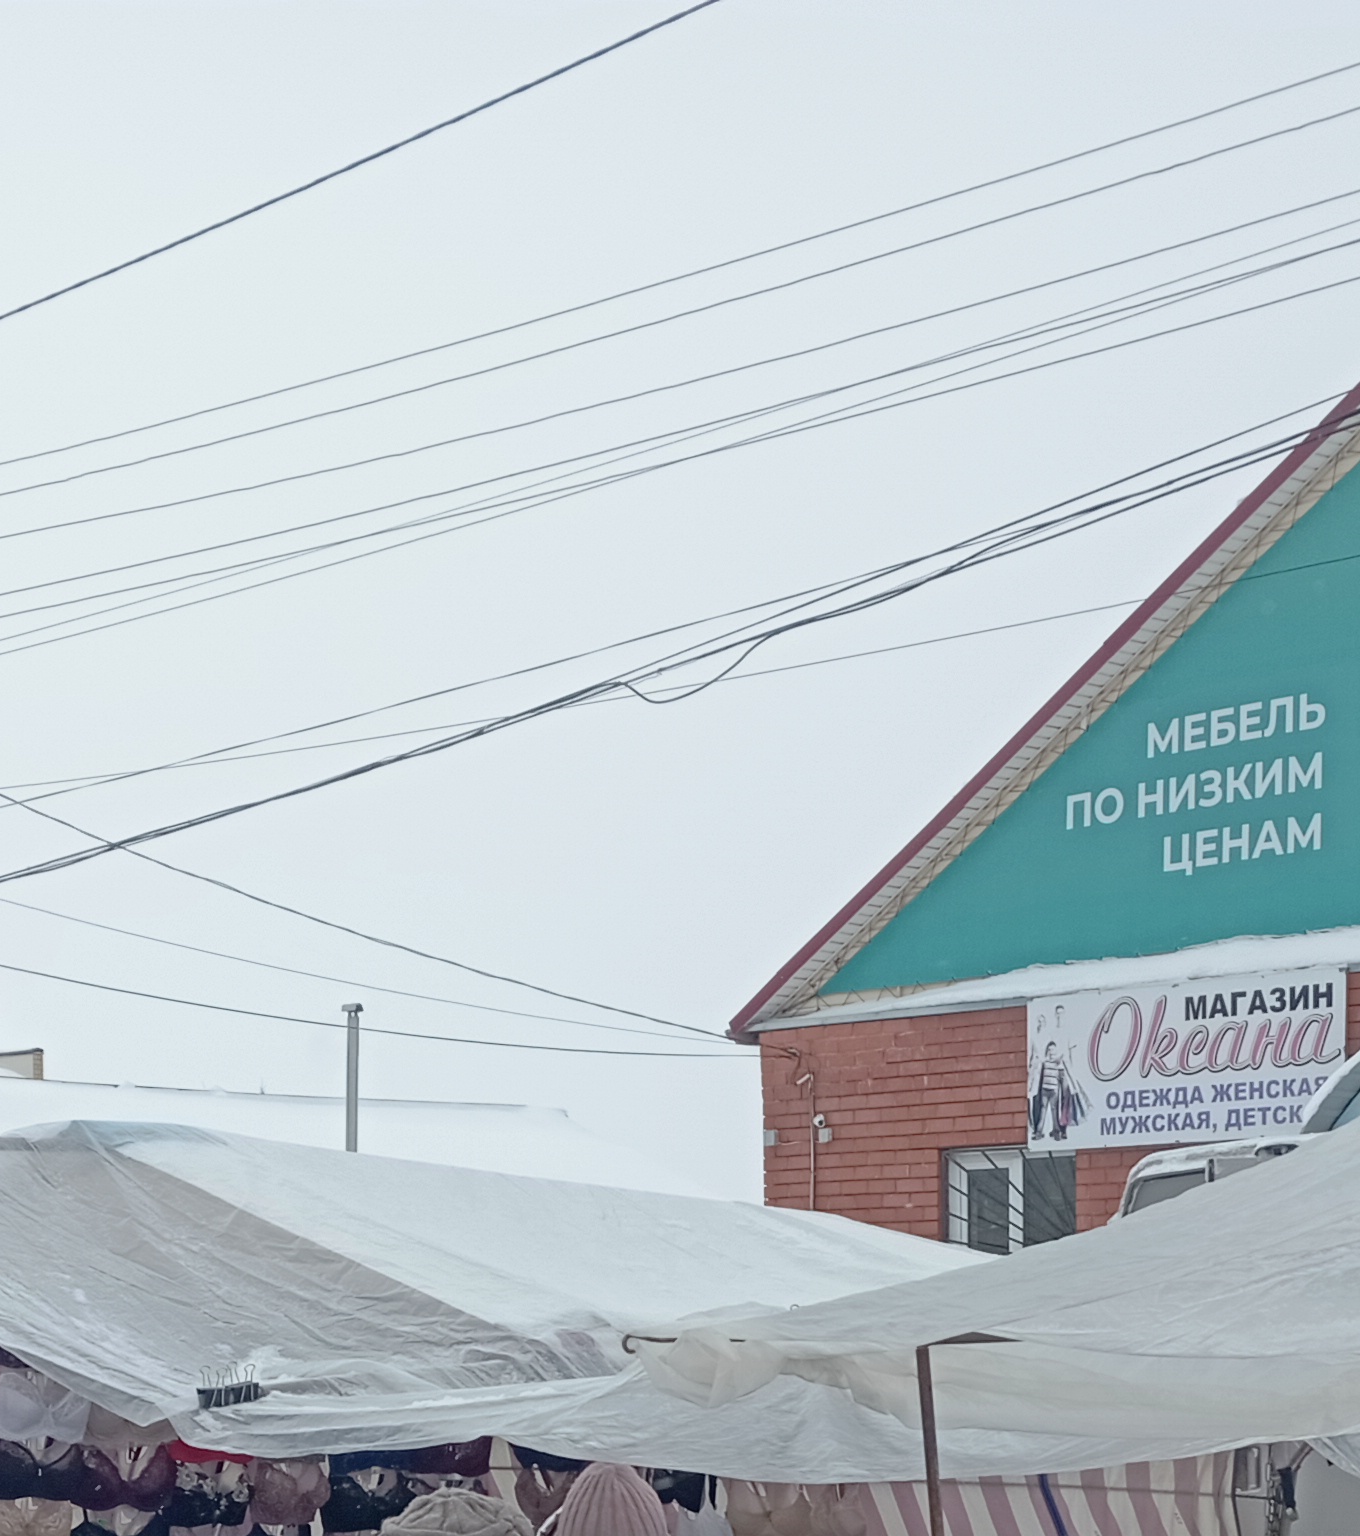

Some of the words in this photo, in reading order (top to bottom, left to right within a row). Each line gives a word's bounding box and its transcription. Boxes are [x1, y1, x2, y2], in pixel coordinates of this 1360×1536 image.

[1146, 692, 1327, 759] МЕБЕЛЬ
[1065, 787, 1125, 830] ПО
[1137, 751, 1323, 819] НИЗКИМ
[1162, 812, 1322, 876] ЦЕНАМ
[1184, 982, 1335, 1022] МАГАЗИН
[1087, 995, 1341, 1082] Оксана
[1099, 1109, 1218, 1136] МУЖСКАЯ,
[1224, 1104, 1304, 1131] ДЕТСК
[1105, 1085, 1205, 1113] ОДЕЖДА
